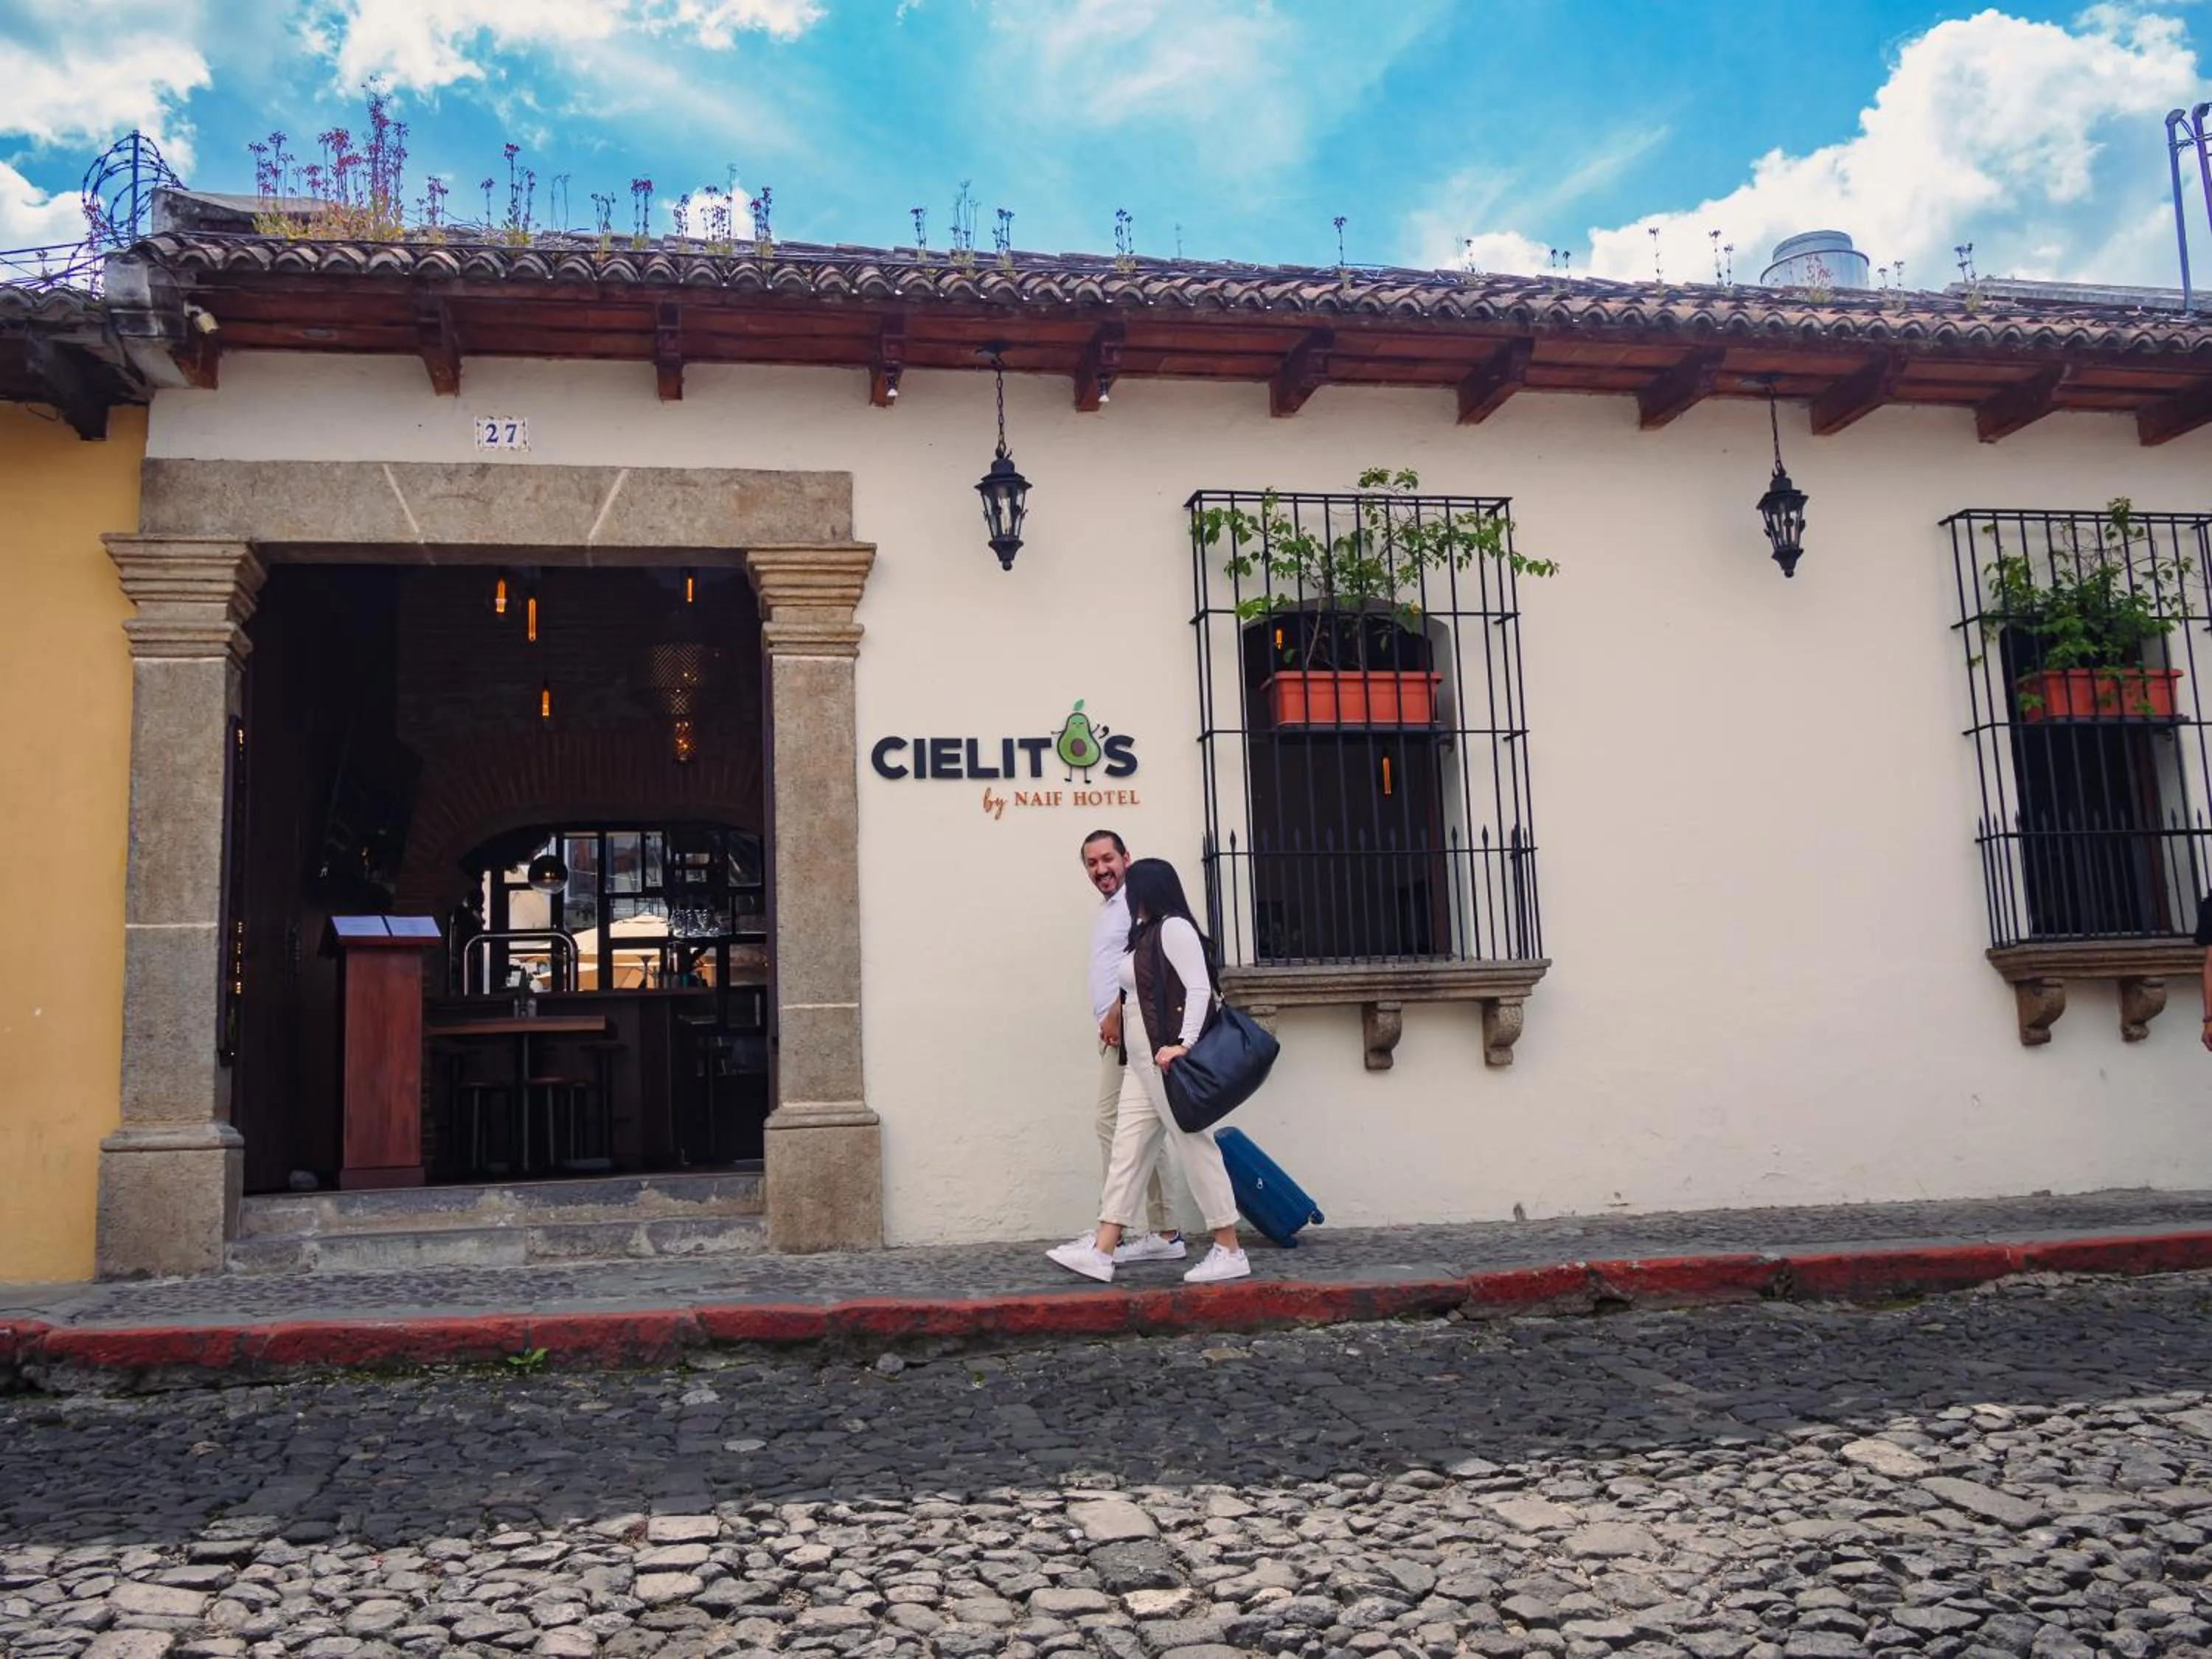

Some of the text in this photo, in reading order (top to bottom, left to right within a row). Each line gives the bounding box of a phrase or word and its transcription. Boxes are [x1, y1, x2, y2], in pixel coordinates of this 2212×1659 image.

[485, 423, 517, 443] 27
[983, 787, 1140, 820] by NAIF HOTEL
